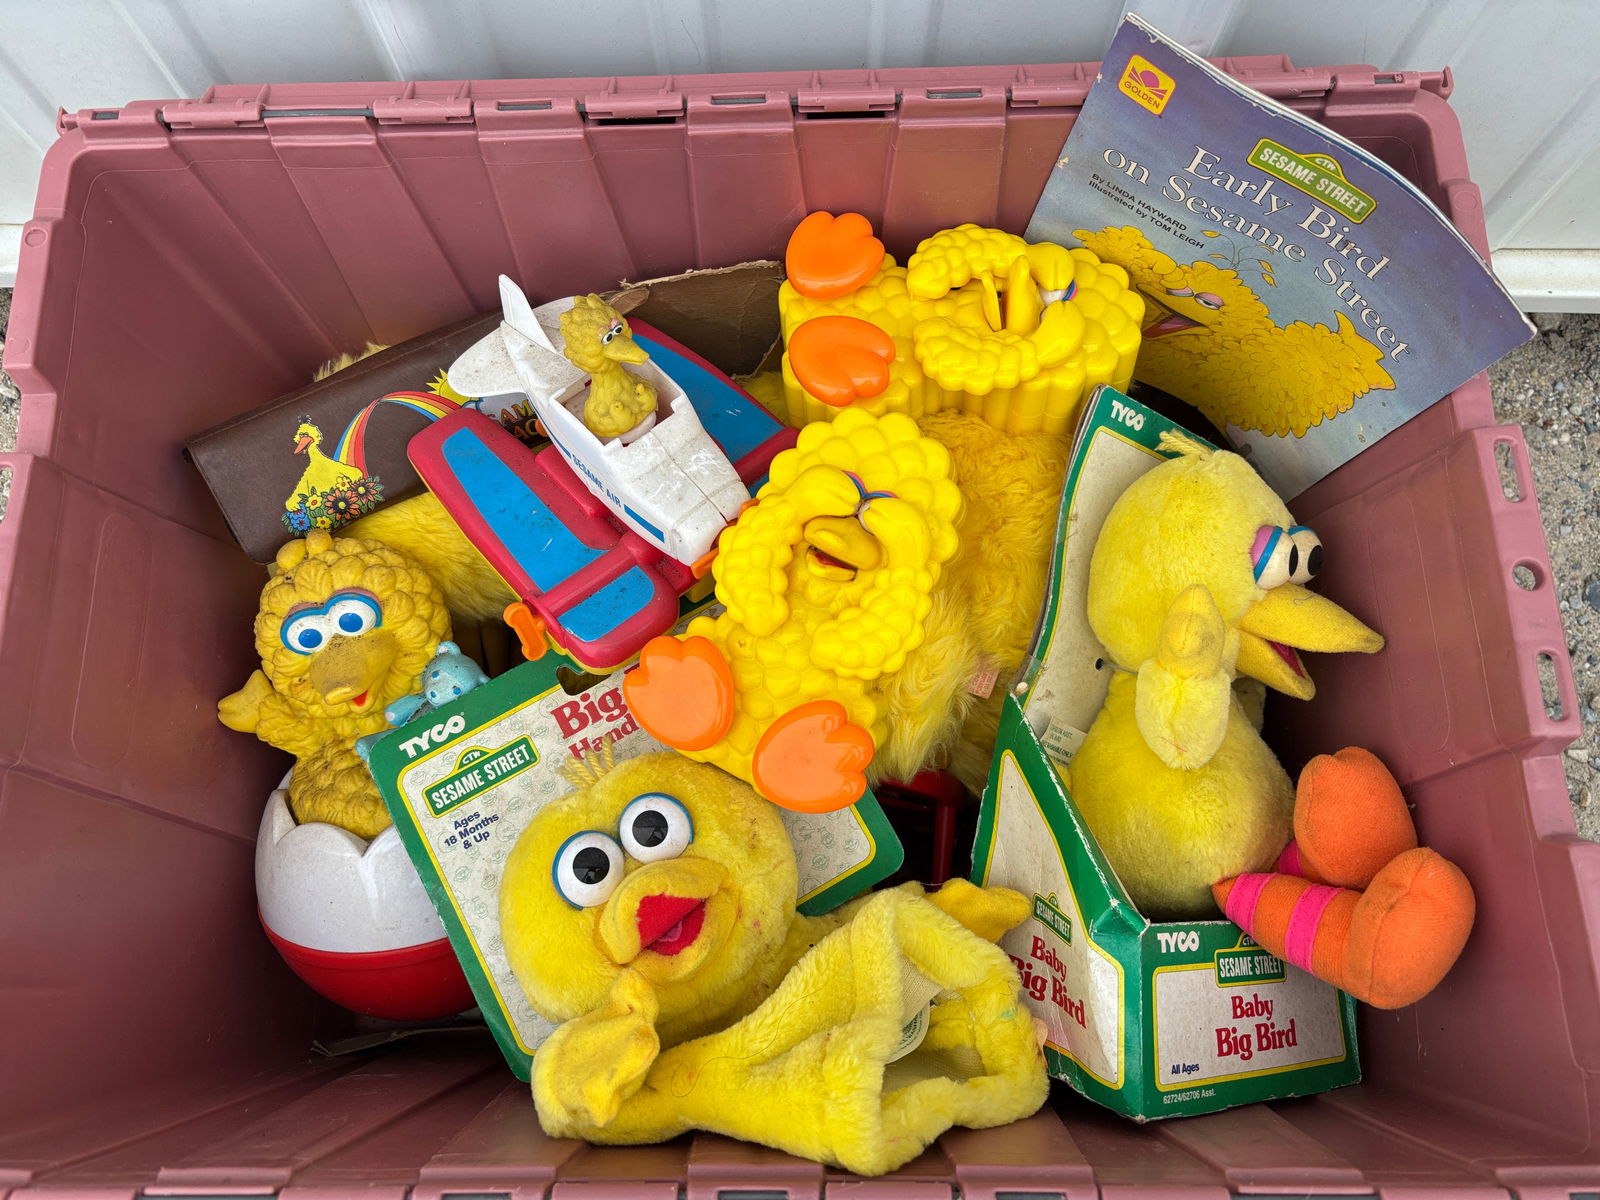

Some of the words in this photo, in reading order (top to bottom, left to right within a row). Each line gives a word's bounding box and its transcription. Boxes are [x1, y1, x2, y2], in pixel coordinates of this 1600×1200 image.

[1124, 81, 1160, 109] GOLDEN
[1259, 147, 1316, 186] SESAME
[1316, 178, 1368, 216] STREET
[1314, 157, 1336, 172] CTW
[1088, 180, 1134, 211] Illustrated
[1136, 207, 1148, 219] by
[1149, 216, 1172, 233] TOM
[1173, 229, 1205, 249] LEIGH
[1092, 173, 1105, 184] By
[1106, 182, 1135, 203] LINDA
[1138, 200, 1188, 231] HAYWARD
[1184, 144, 1293, 216] Early
[1297, 203, 1391, 281] Bird
[1103, 148, 1150, 186] on
[1162, 175, 1306, 262] Sesame
[1313, 257, 1411, 363] Street
[1110, 400, 1144, 431] TYCO
[572, 453, 605, 492] SESAME
[606, 488, 622, 508] AIR
[550, 687, 629, 740] Big
[398, 715, 466, 758] TYCO
[431, 769, 485, 809] SESAME
[487, 743, 532, 781] STREET
[462, 750, 481, 765] CTW
[444, 836, 458, 848] 18
[458, 813, 500, 840] Months
[453, 811, 481, 831] Ages
[463, 838, 473, 850] &
[473, 830, 491, 846] Up
[1030, 935, 1067, 982] Baby
[1157, 930, 1200, 953] TYCO
[1219, 956, 1253, 978] SESAME
[1254, 954, 1282, 976] STREET
[1050, 975, 1087, 1029] Bird
[1230, 993, 1274, 1021] Baby
[1215, 1027, 1254, 1061] Big
[1255, 1018, 1298, 1052] Bird
[1171, 1064, 1181, 1075] All
[1181, 1063, 1200, 1075] Ages
[1163, 1090, 1200, 1104] 62724/62706
